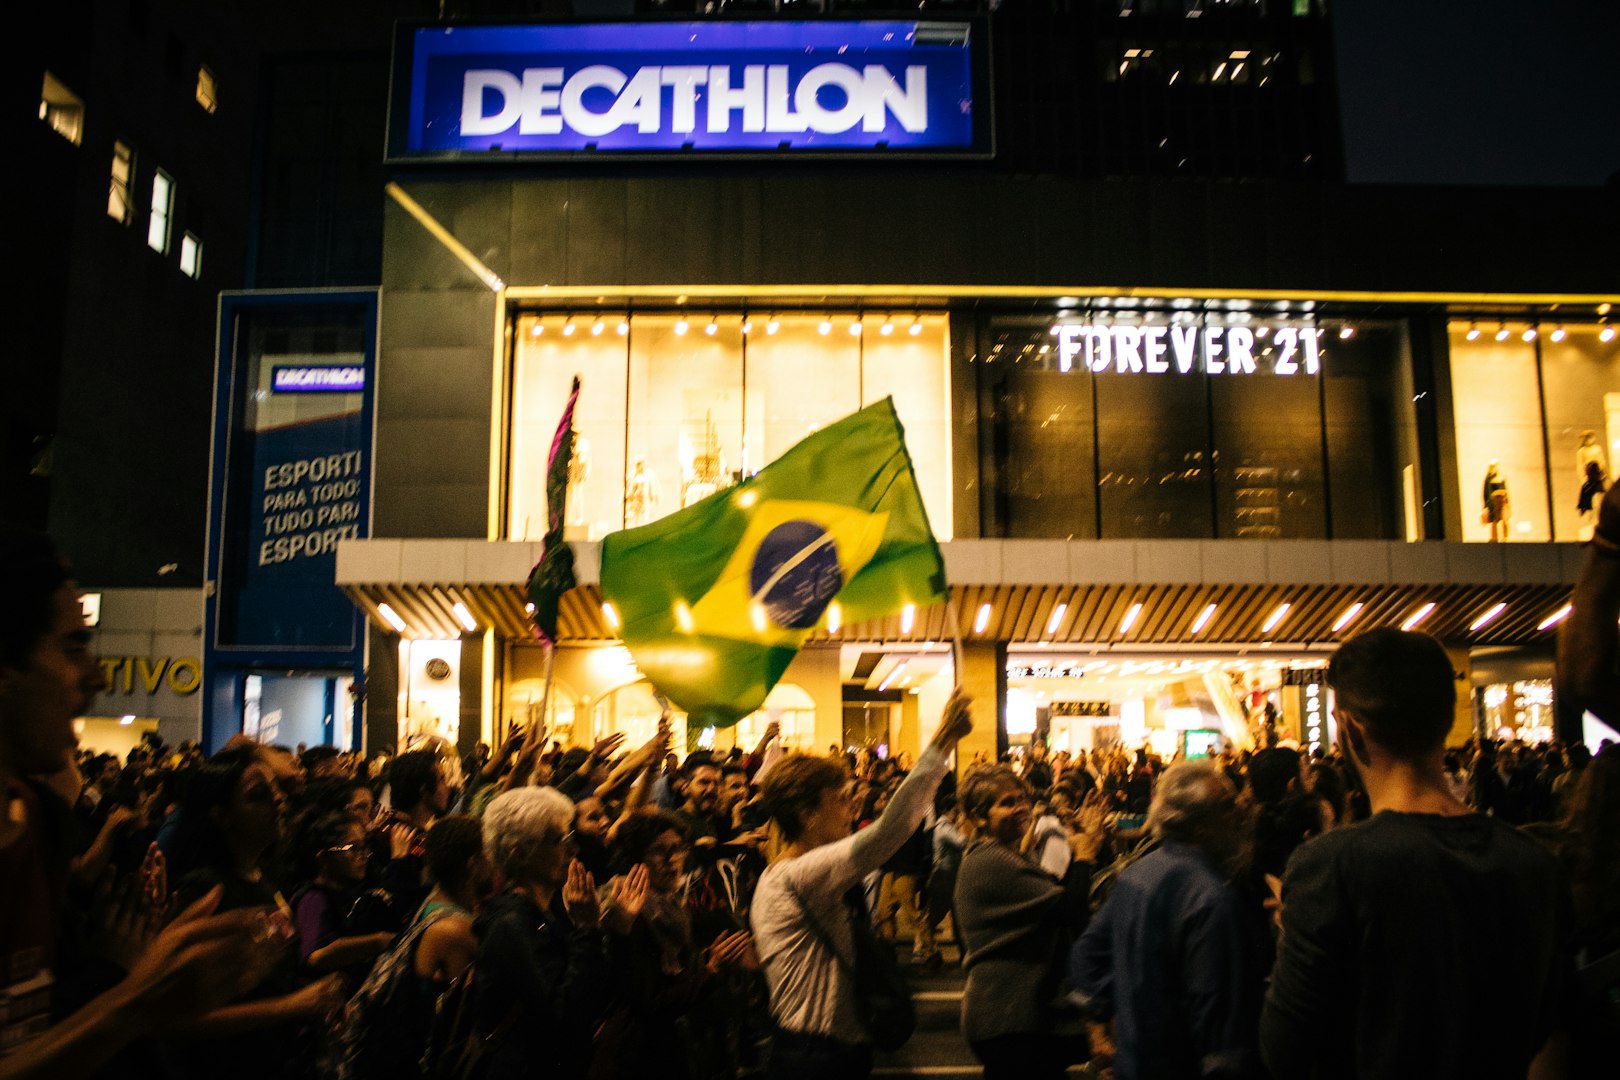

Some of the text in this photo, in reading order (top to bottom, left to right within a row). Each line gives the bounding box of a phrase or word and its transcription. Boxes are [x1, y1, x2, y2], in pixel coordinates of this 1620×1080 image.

[460, 63, 928, 137] DECATHLON
[1057, 325, 1321, 376] FOREVER 21
[263, 488, 307, 514] PARA
[263, 508, 314, 536] TUDO
